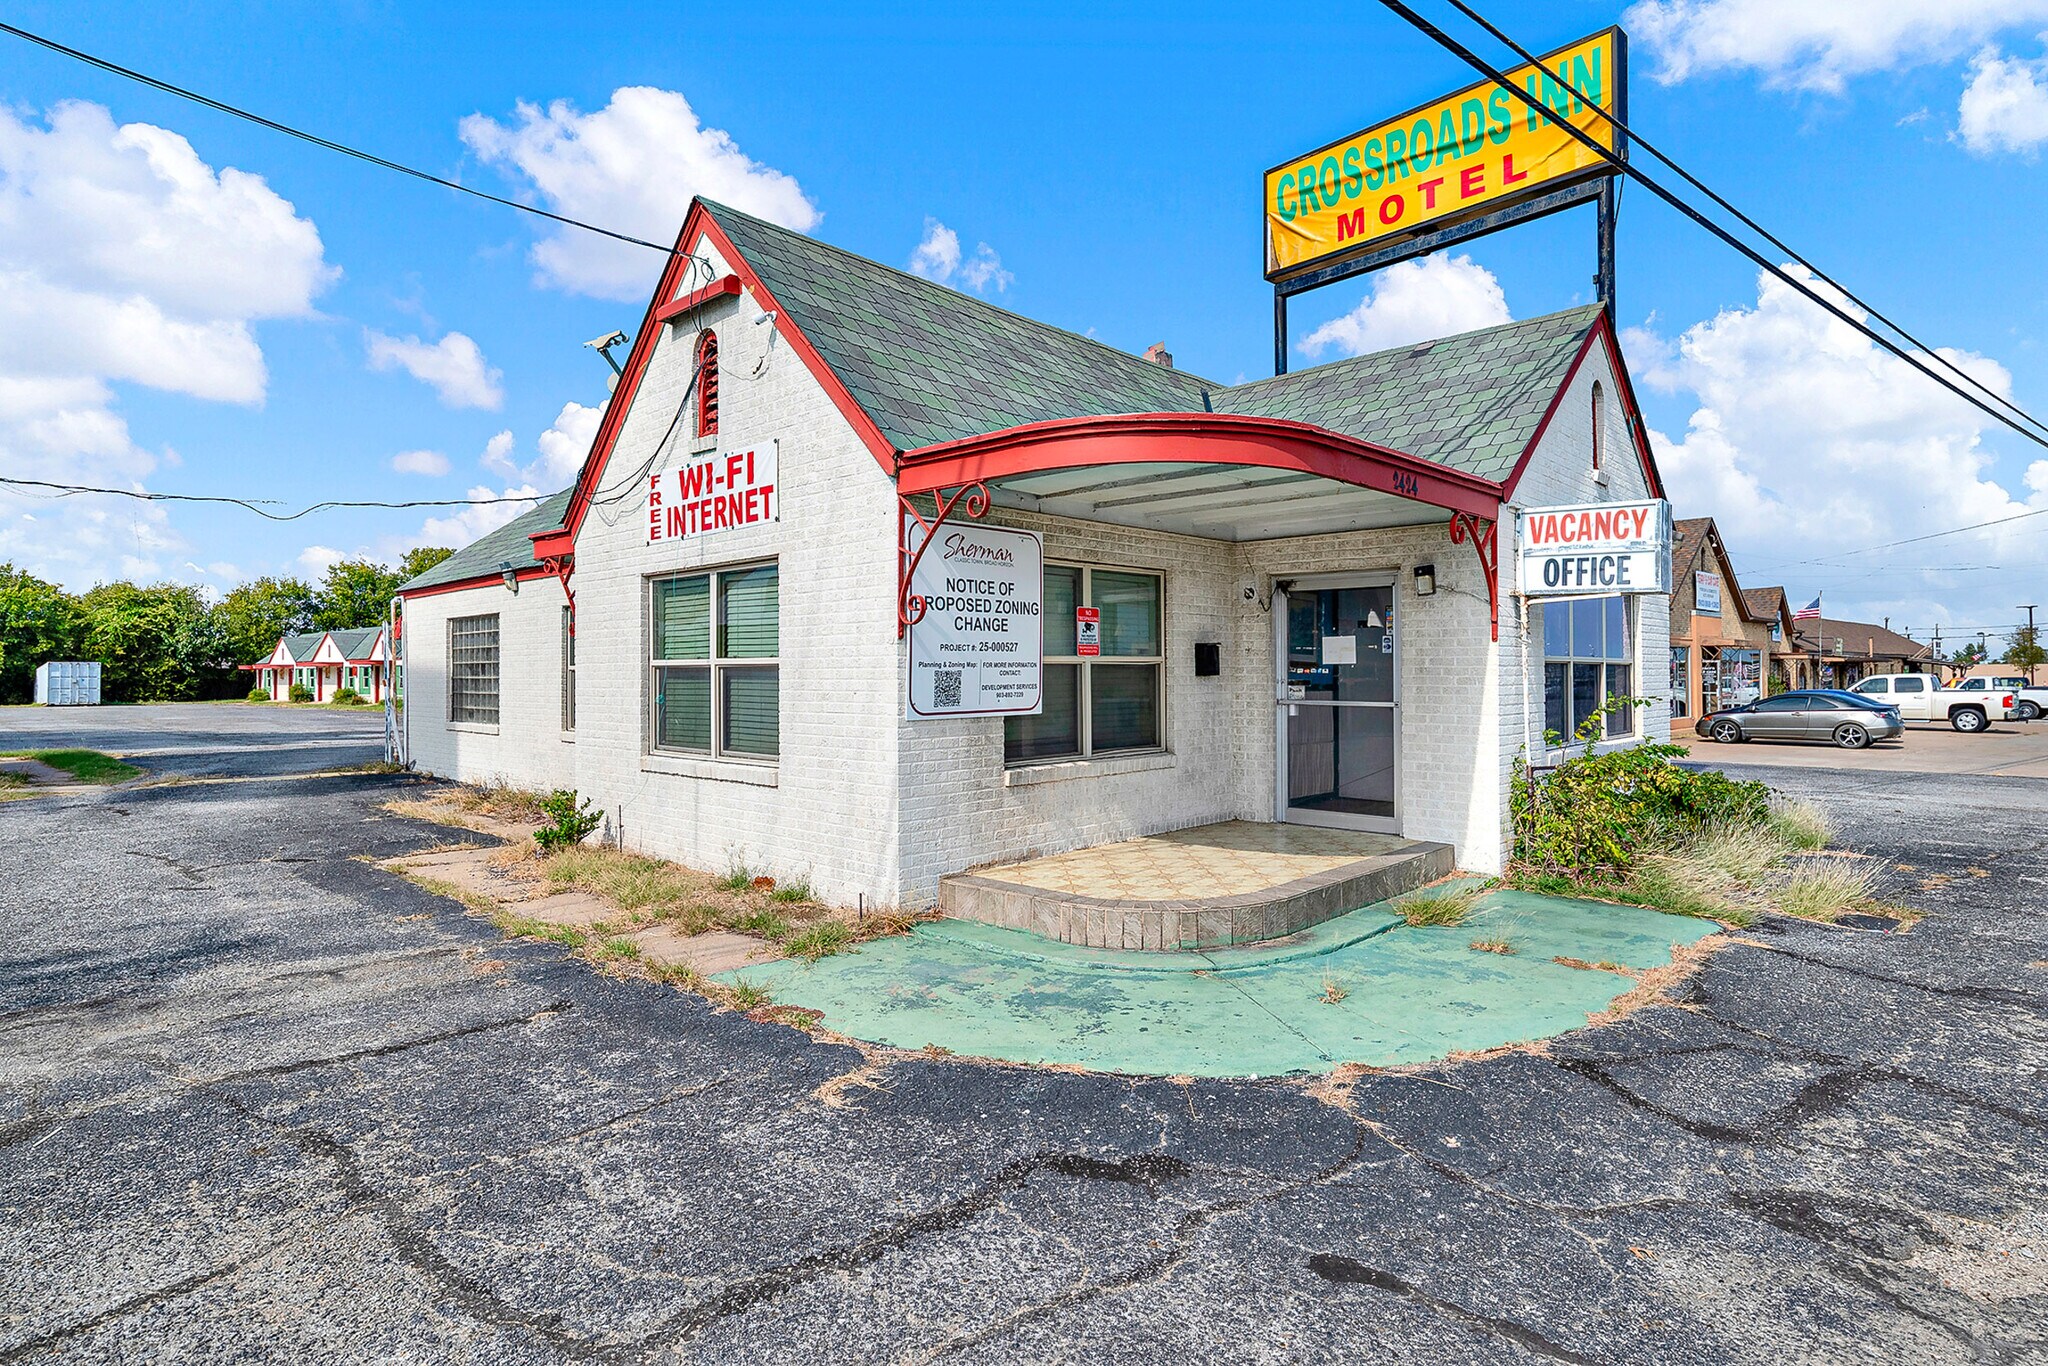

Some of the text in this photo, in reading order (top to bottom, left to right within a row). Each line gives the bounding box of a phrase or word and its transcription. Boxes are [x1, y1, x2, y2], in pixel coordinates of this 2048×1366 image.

[1276, 45, 1603, 223] CROSSROADS INN
[1336, 153, 1529, 243] MOTEL
[678, 450, 755, 501] WI-FI
[1392, 470, 1419, 498] 2424
[649, 474, 663, 541] FREE
[666, 484, 775, 539] INTERNET
[1528, 508, 1649, 545] VACANCY
[943, 532, 1015, 563] Sherman
[946, 576, 1016, 597] NOTICE OF
[1542, 555, 1632, 588] OFFICE
[994, 599, 1040, 616] ZONING
[954, 615, 1009, 633] CHANGE
[939, 643, 970, 652] PROJECT
[979, 640, 1019, 653] 25-000527
[918, 660, 942, 669] Planning
[948, 661, 966, 670] Zoning
[981, 683, 1016, 691] DEVELOPMENT
